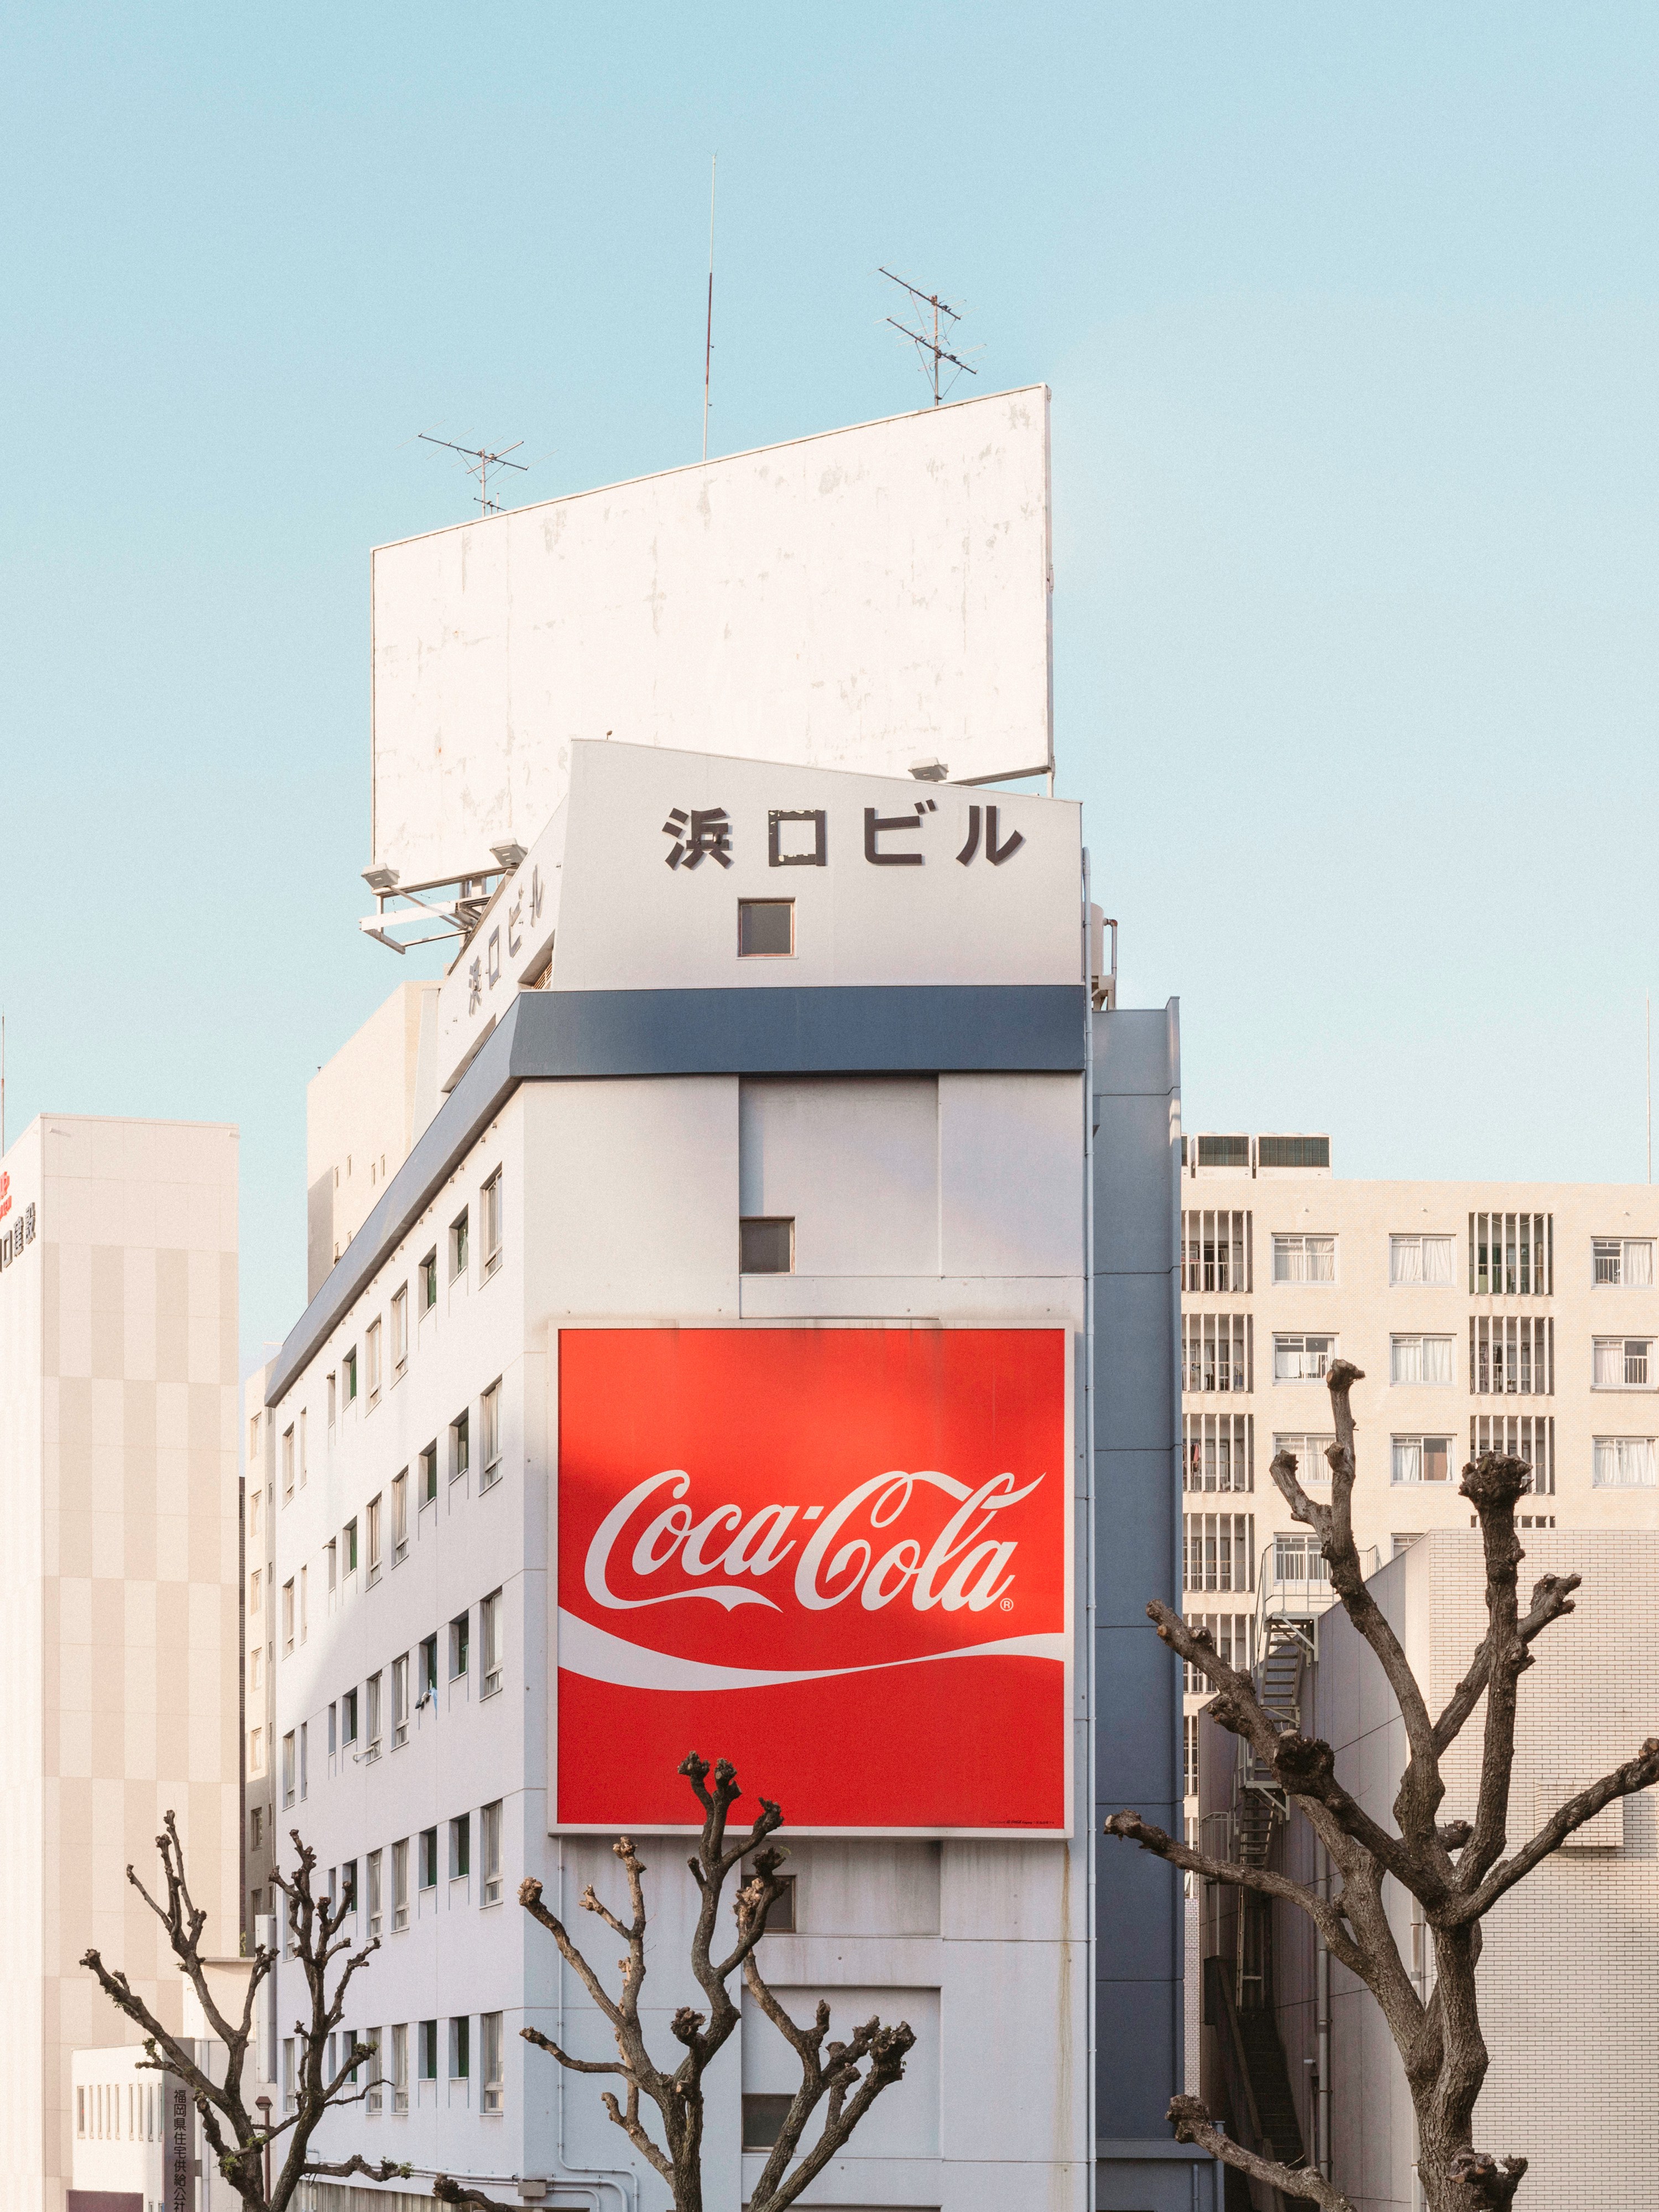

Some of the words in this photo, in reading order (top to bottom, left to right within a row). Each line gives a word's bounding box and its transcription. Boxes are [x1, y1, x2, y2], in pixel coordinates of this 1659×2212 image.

[661, 799, 1024, 870] 浜口ビル
[468, 863, 545, 1017] 浜口ビル
[0, 1202, 35, 1272] 口建設
[584, 1469, 1046, 1613] Coca-Cola
[174, 2090, 186, 2212] 福岡県住宅供給公社
